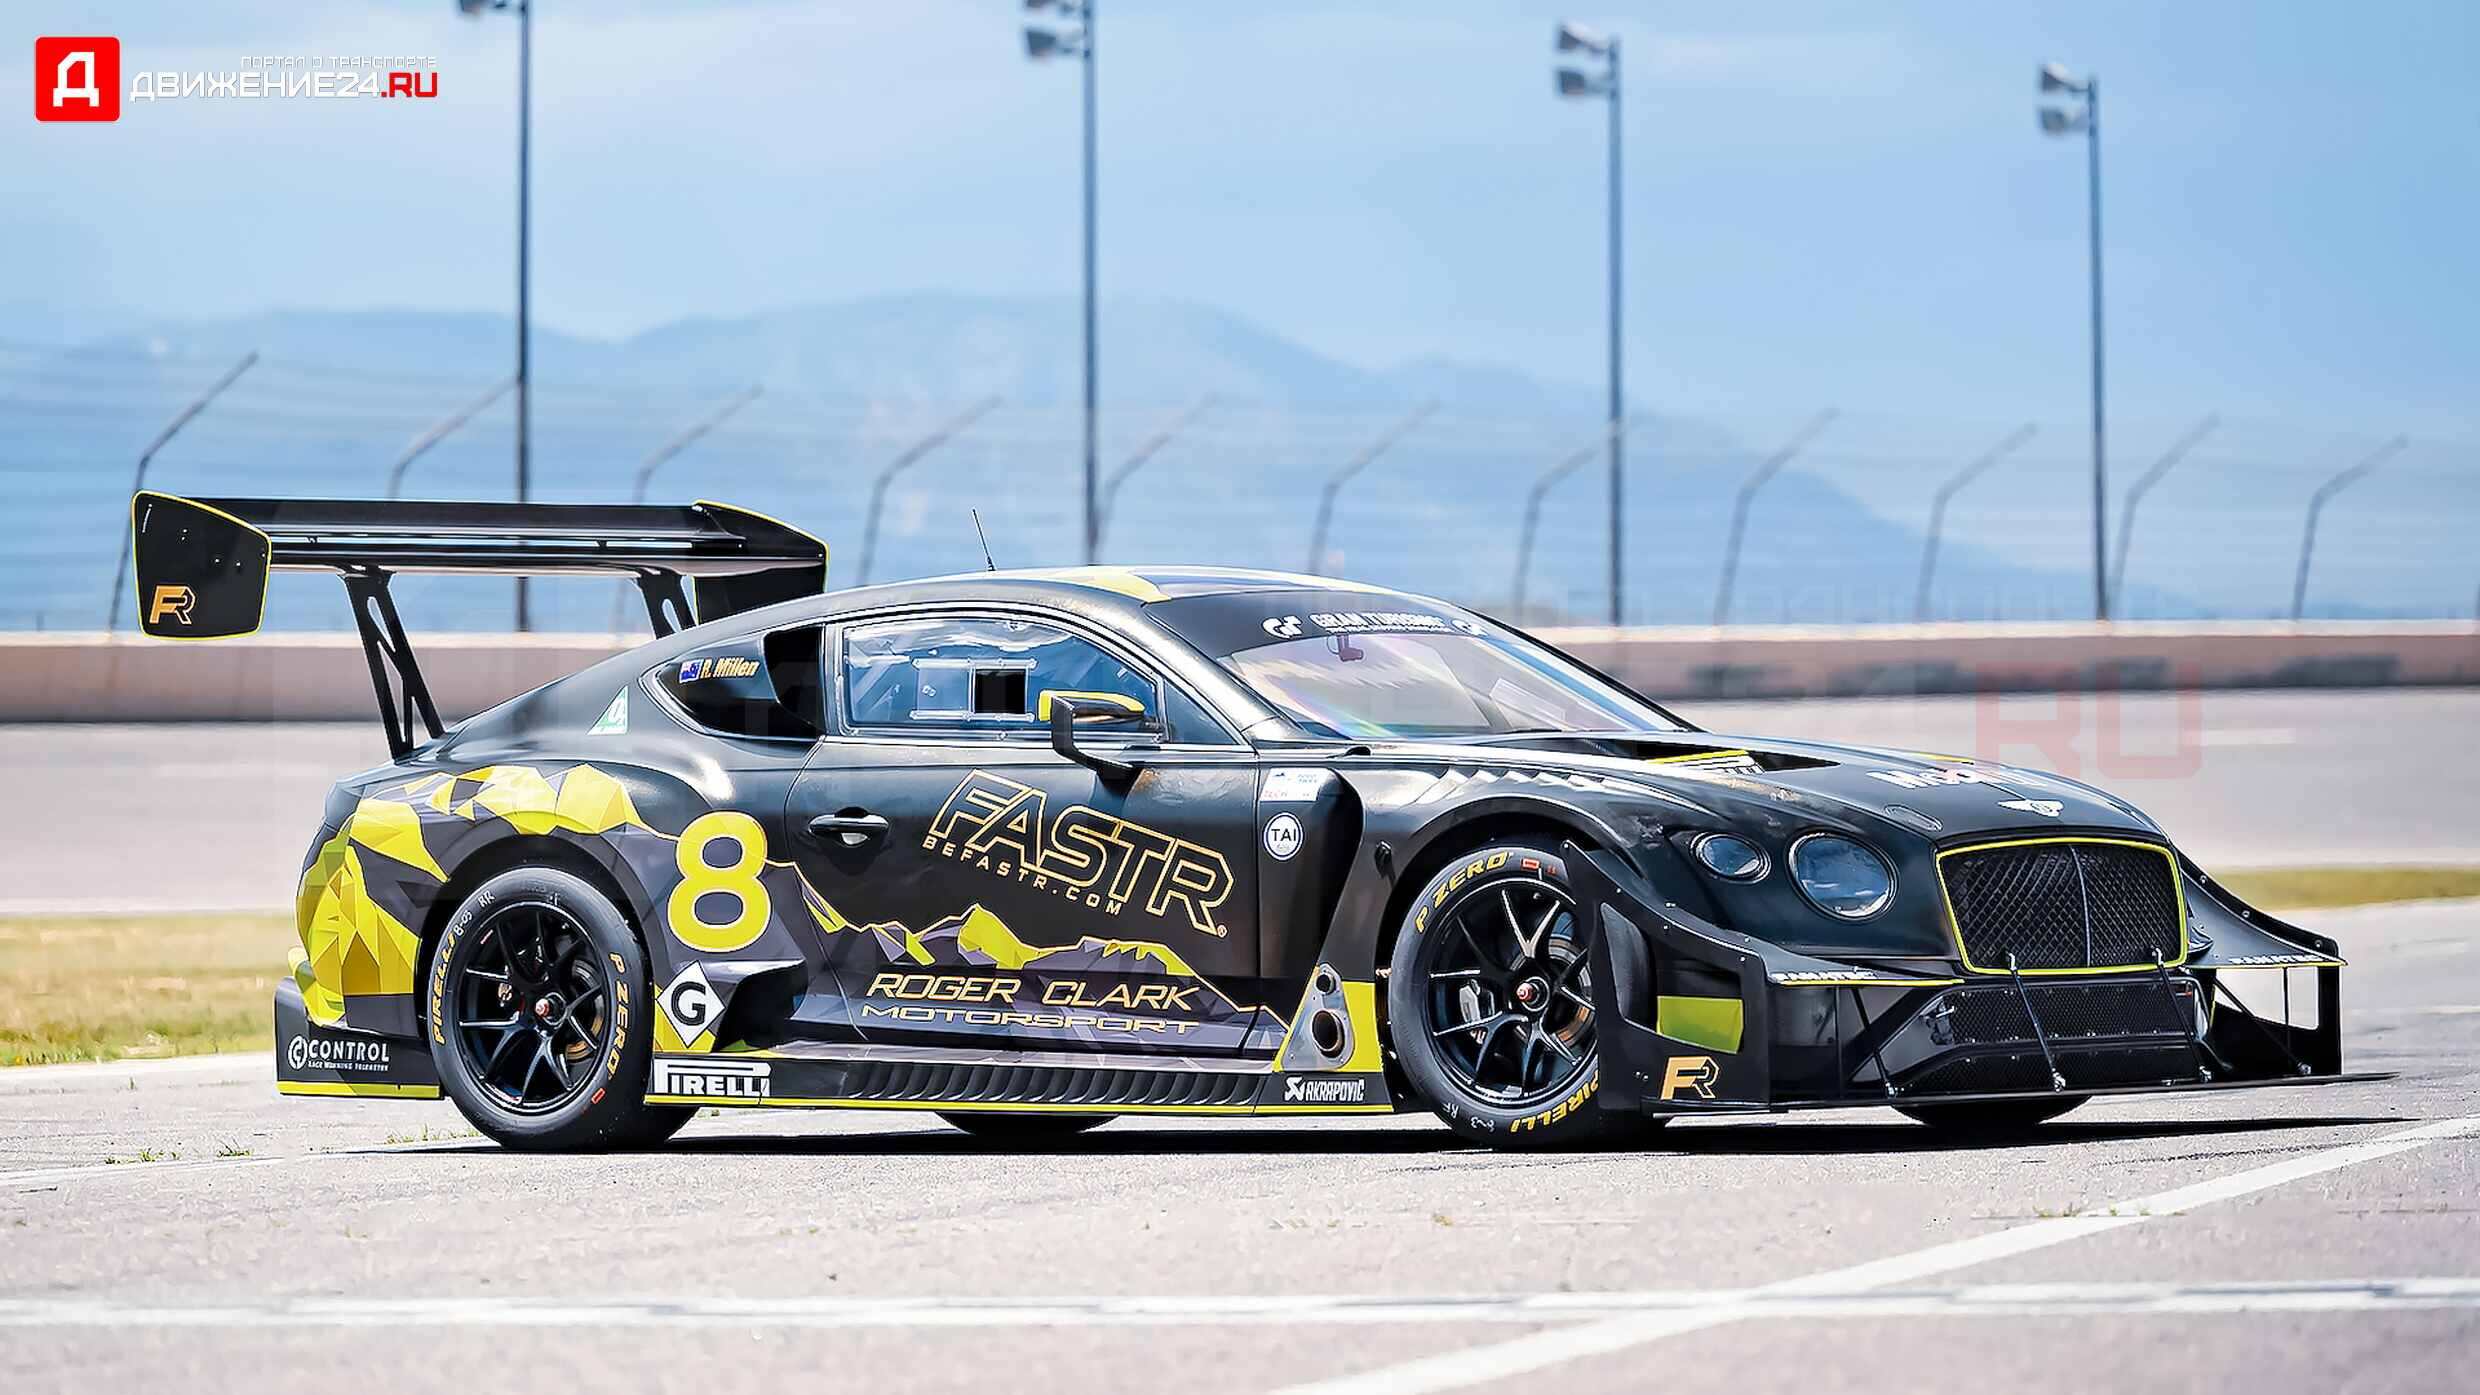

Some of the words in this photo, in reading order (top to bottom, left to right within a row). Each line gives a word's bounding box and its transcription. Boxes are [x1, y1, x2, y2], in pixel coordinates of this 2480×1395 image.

[713, 657, 759, 677] Millen
[1271, 829, 1297, 842] TAI
[667, 811, 771, 952] 8
[1433, 851, 1509, 908] ZERO
[670, 981, 706, 1026] G
[866, 973, 1021, 1003] ROGER
[1042, 980, 1201, 1010] CLARK
[605, 981, 630, 1077] ZERO
[861, 1005, 1200, 1034] MOTORSPORT
[653, 1058, 772, 1096] PIRELLI
